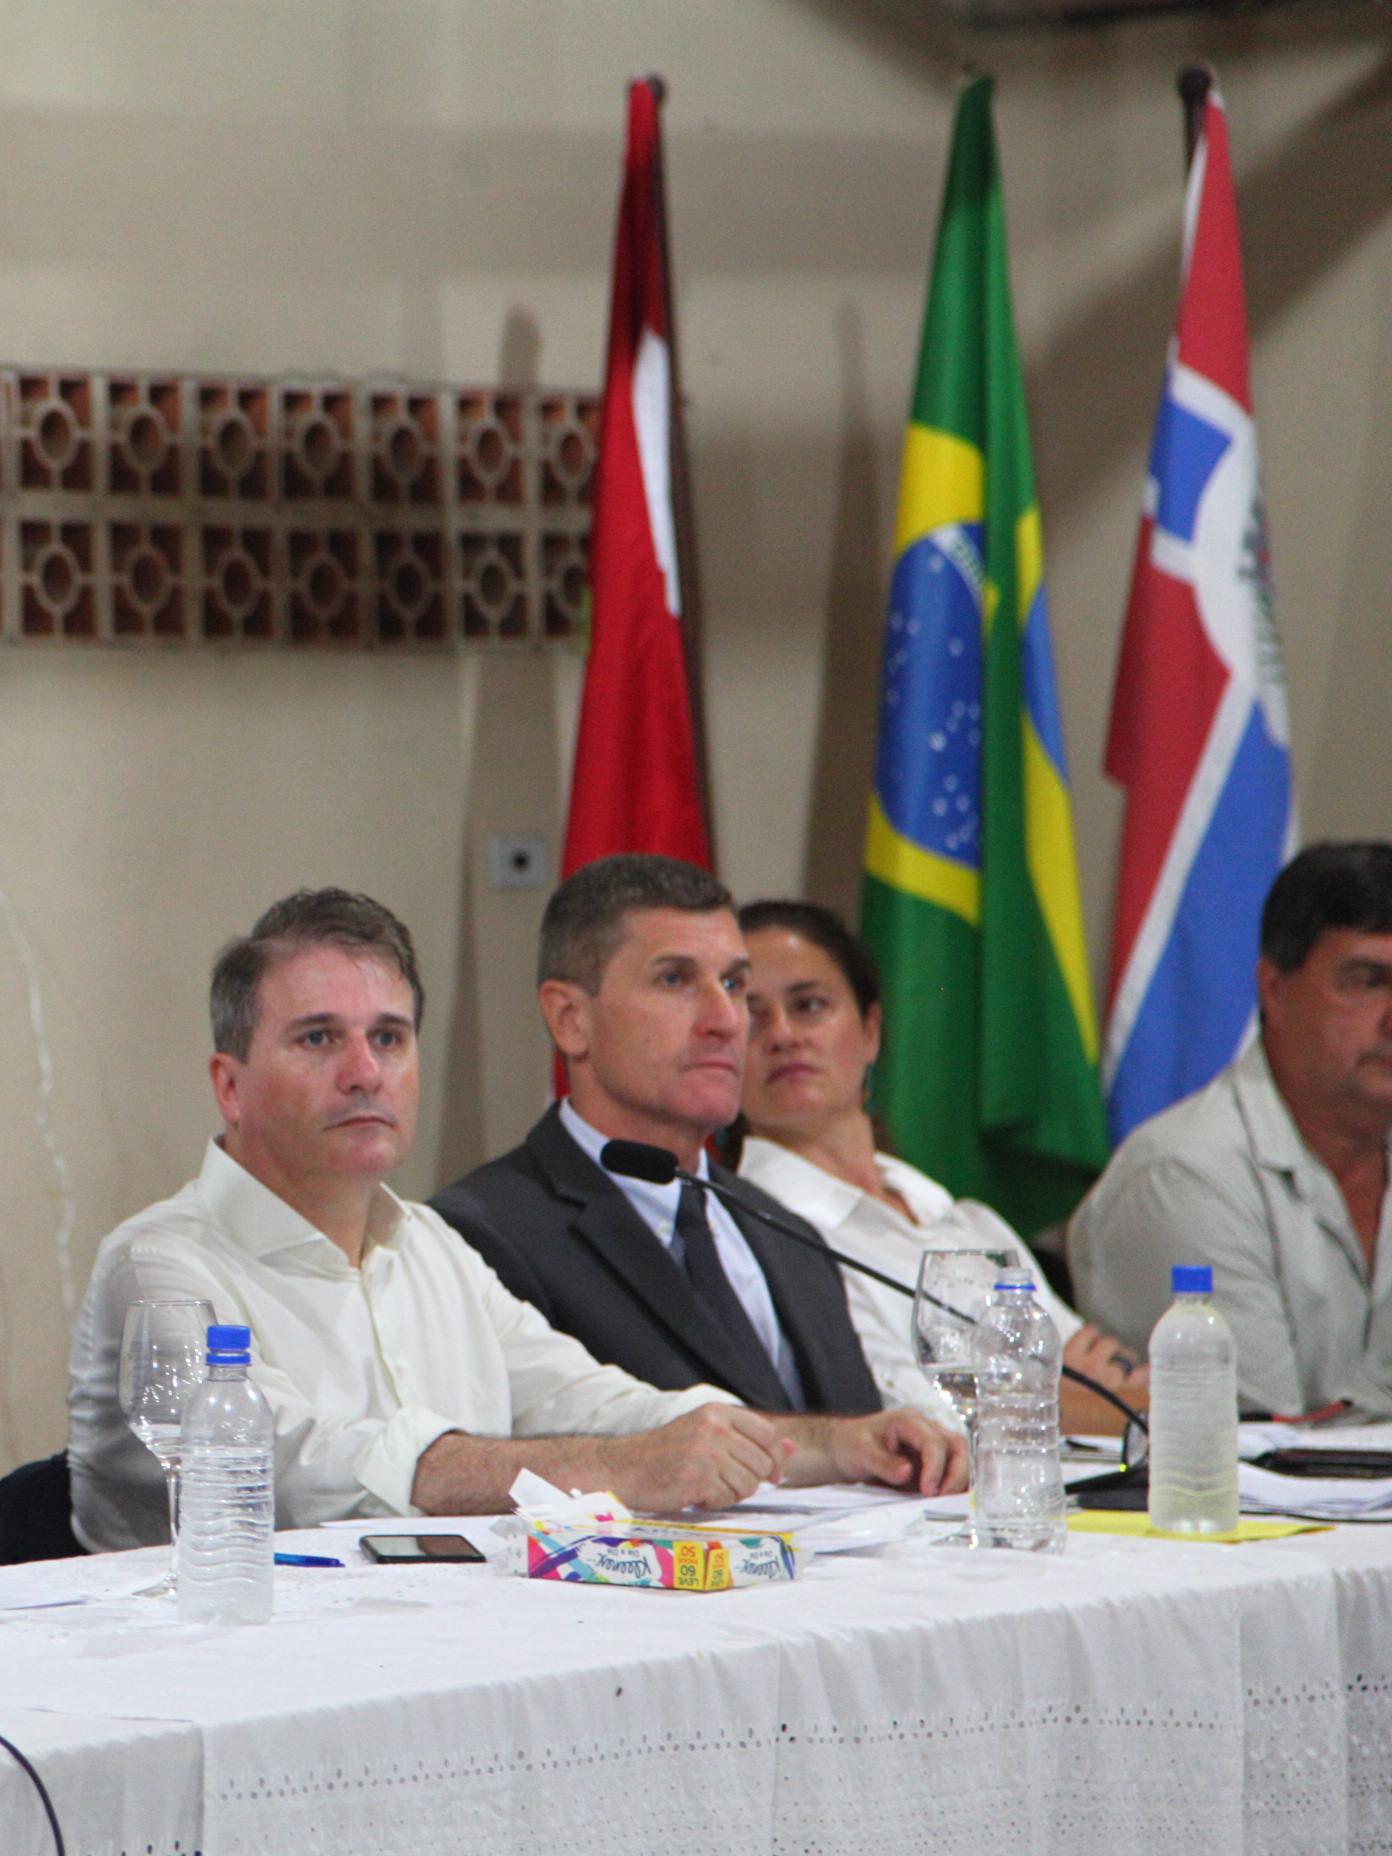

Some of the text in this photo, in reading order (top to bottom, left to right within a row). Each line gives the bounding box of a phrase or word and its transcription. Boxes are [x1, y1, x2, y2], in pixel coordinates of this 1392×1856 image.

[680, 1545, 696, 1557] 50
[595, 1552, 652, 1579] Kleenex
[680, 1565, 696, 1576] 60
[678, 1576, 699, 1586] LEVE
